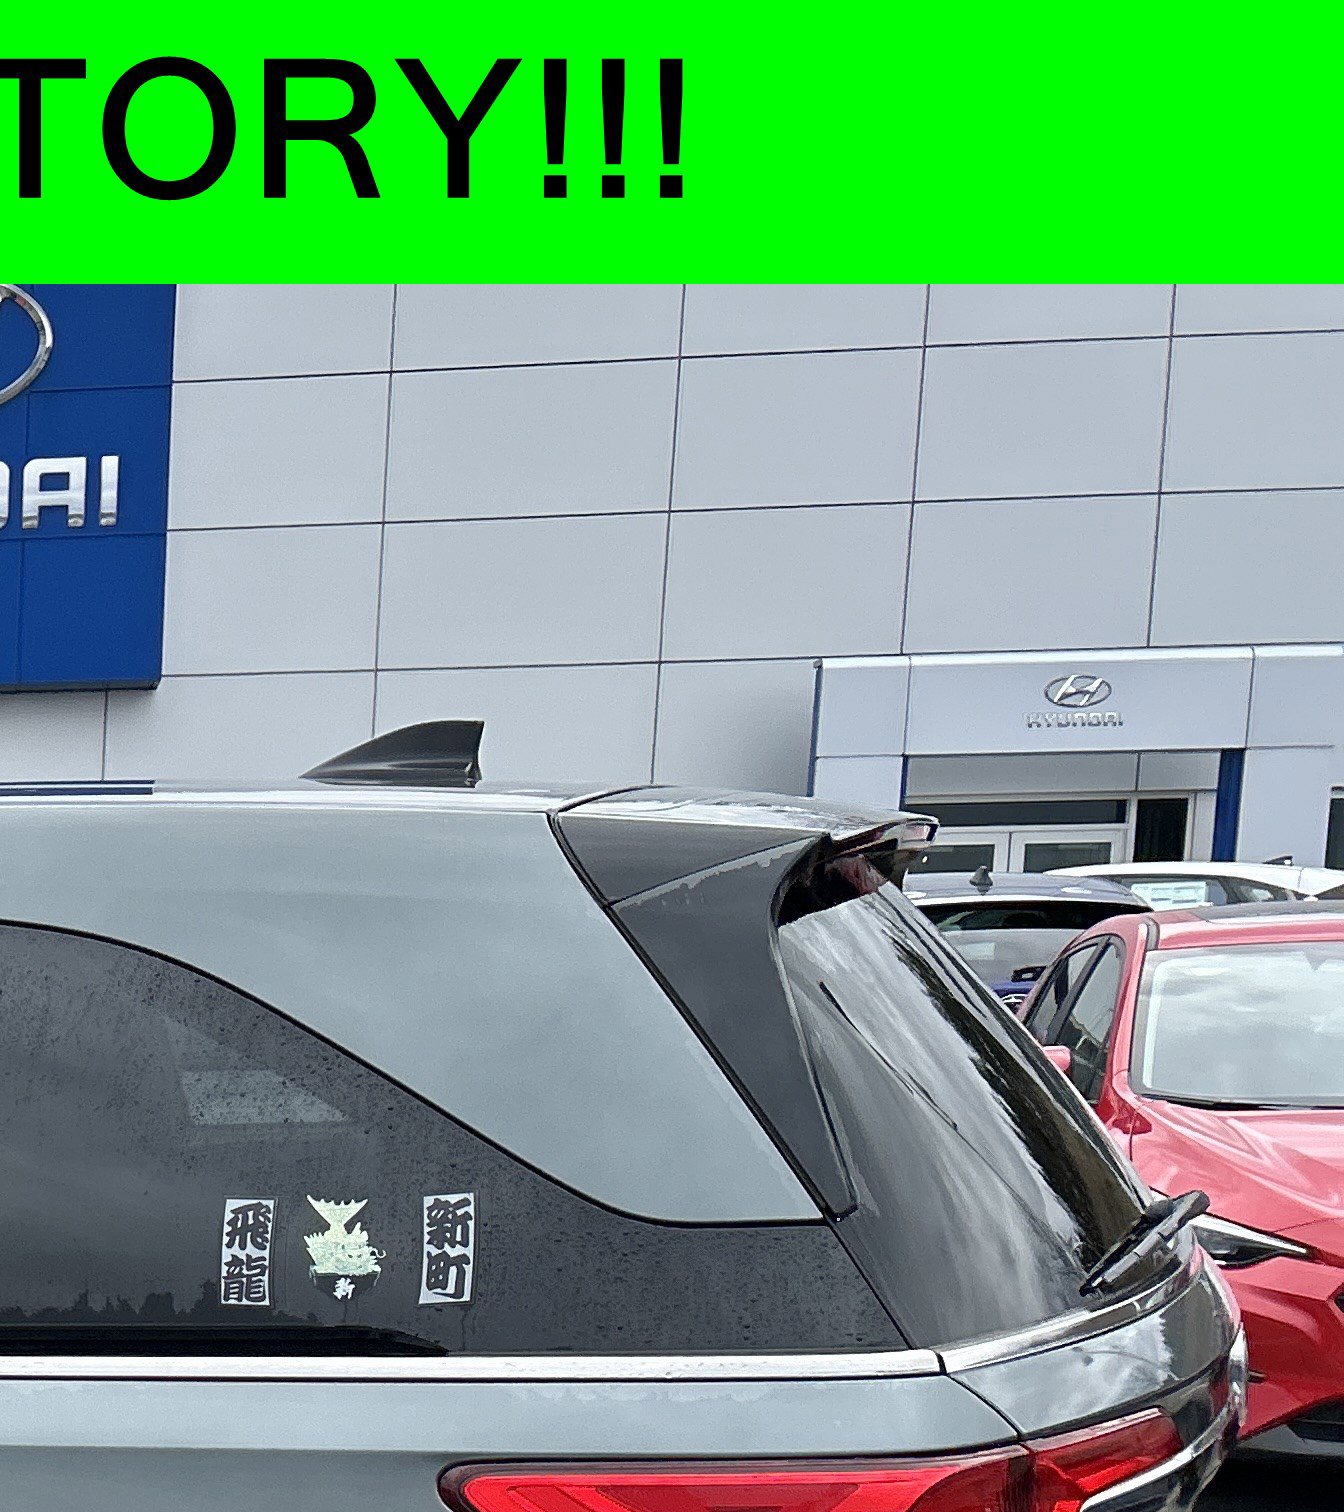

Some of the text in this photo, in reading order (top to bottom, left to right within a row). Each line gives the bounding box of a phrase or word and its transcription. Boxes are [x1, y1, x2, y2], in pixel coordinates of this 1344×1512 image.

[1025, 711, 1124, 728] HYUNDAI
[222, 1201, 272, 1303] 飛龍
[425, 1197, 474, 1300] 新町
